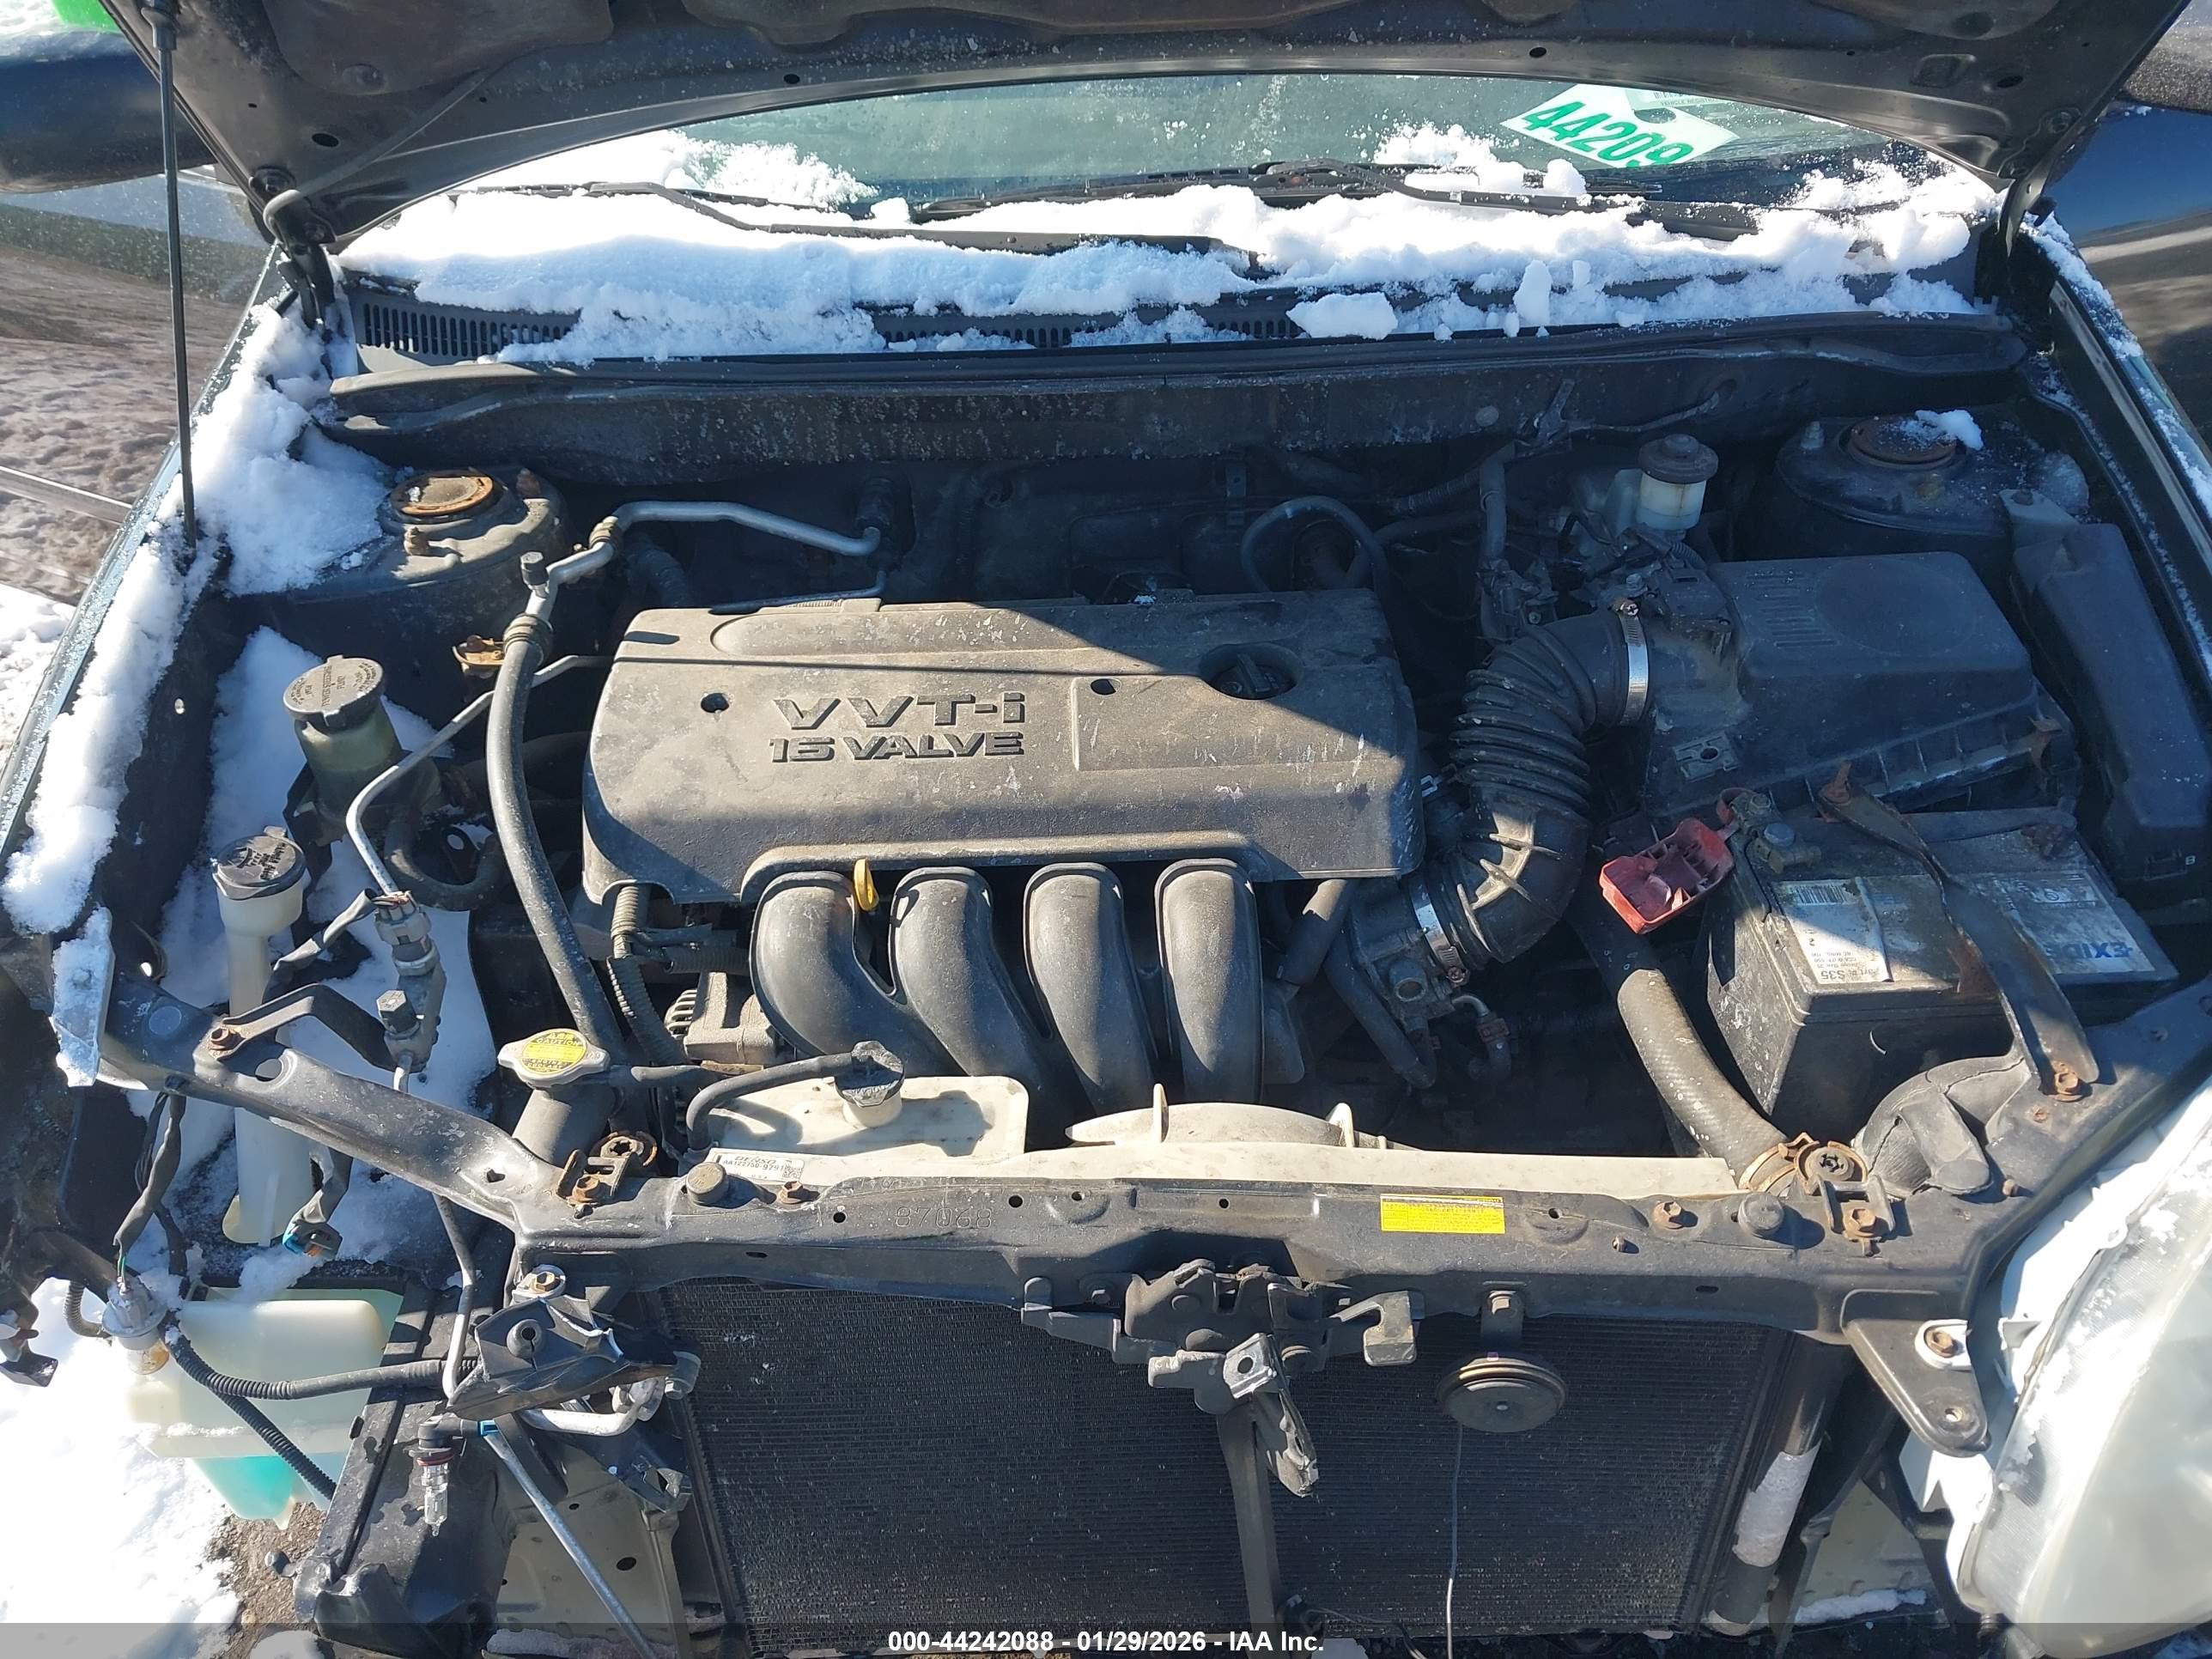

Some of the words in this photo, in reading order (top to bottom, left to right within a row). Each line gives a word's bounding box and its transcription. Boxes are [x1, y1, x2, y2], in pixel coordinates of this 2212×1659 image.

[773, 692, 1024, 730] VVT-i
[769, 735, 836, 763] 16
[842, 731, 1024, 761] VALVE
[1820, 969, 1845, 980] S35
